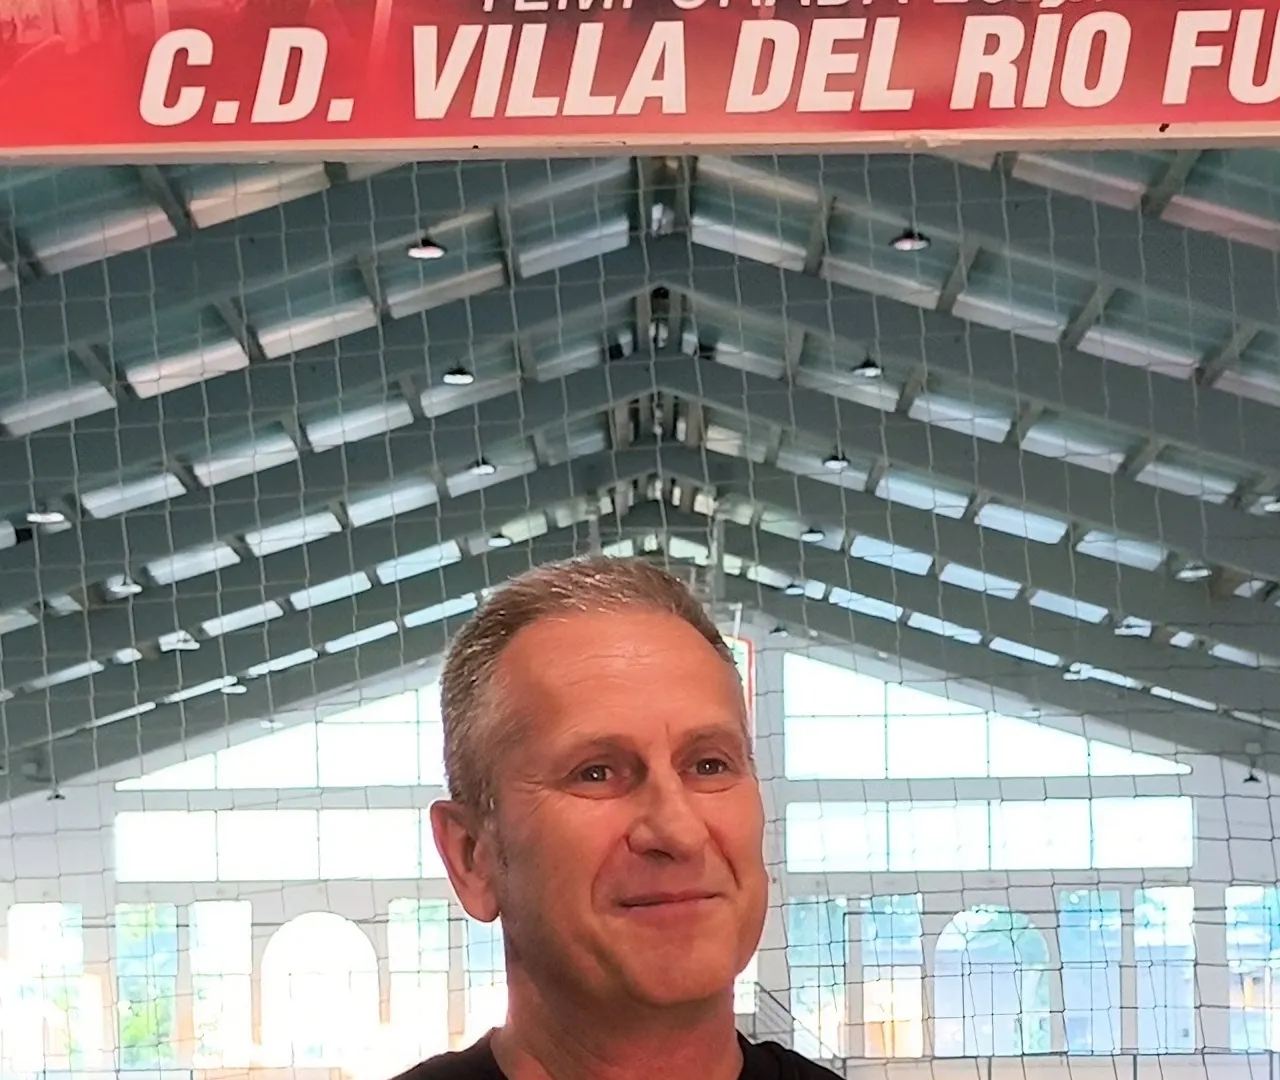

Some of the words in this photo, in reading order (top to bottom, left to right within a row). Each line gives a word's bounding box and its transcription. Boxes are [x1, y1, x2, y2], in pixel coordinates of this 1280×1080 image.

[138, 26, 355, 126] C.D.
[413, 20, 686, 120] VILLA
[725, 16, 915, 113] DEL
[949, 1, 1132, 110] RÍO
